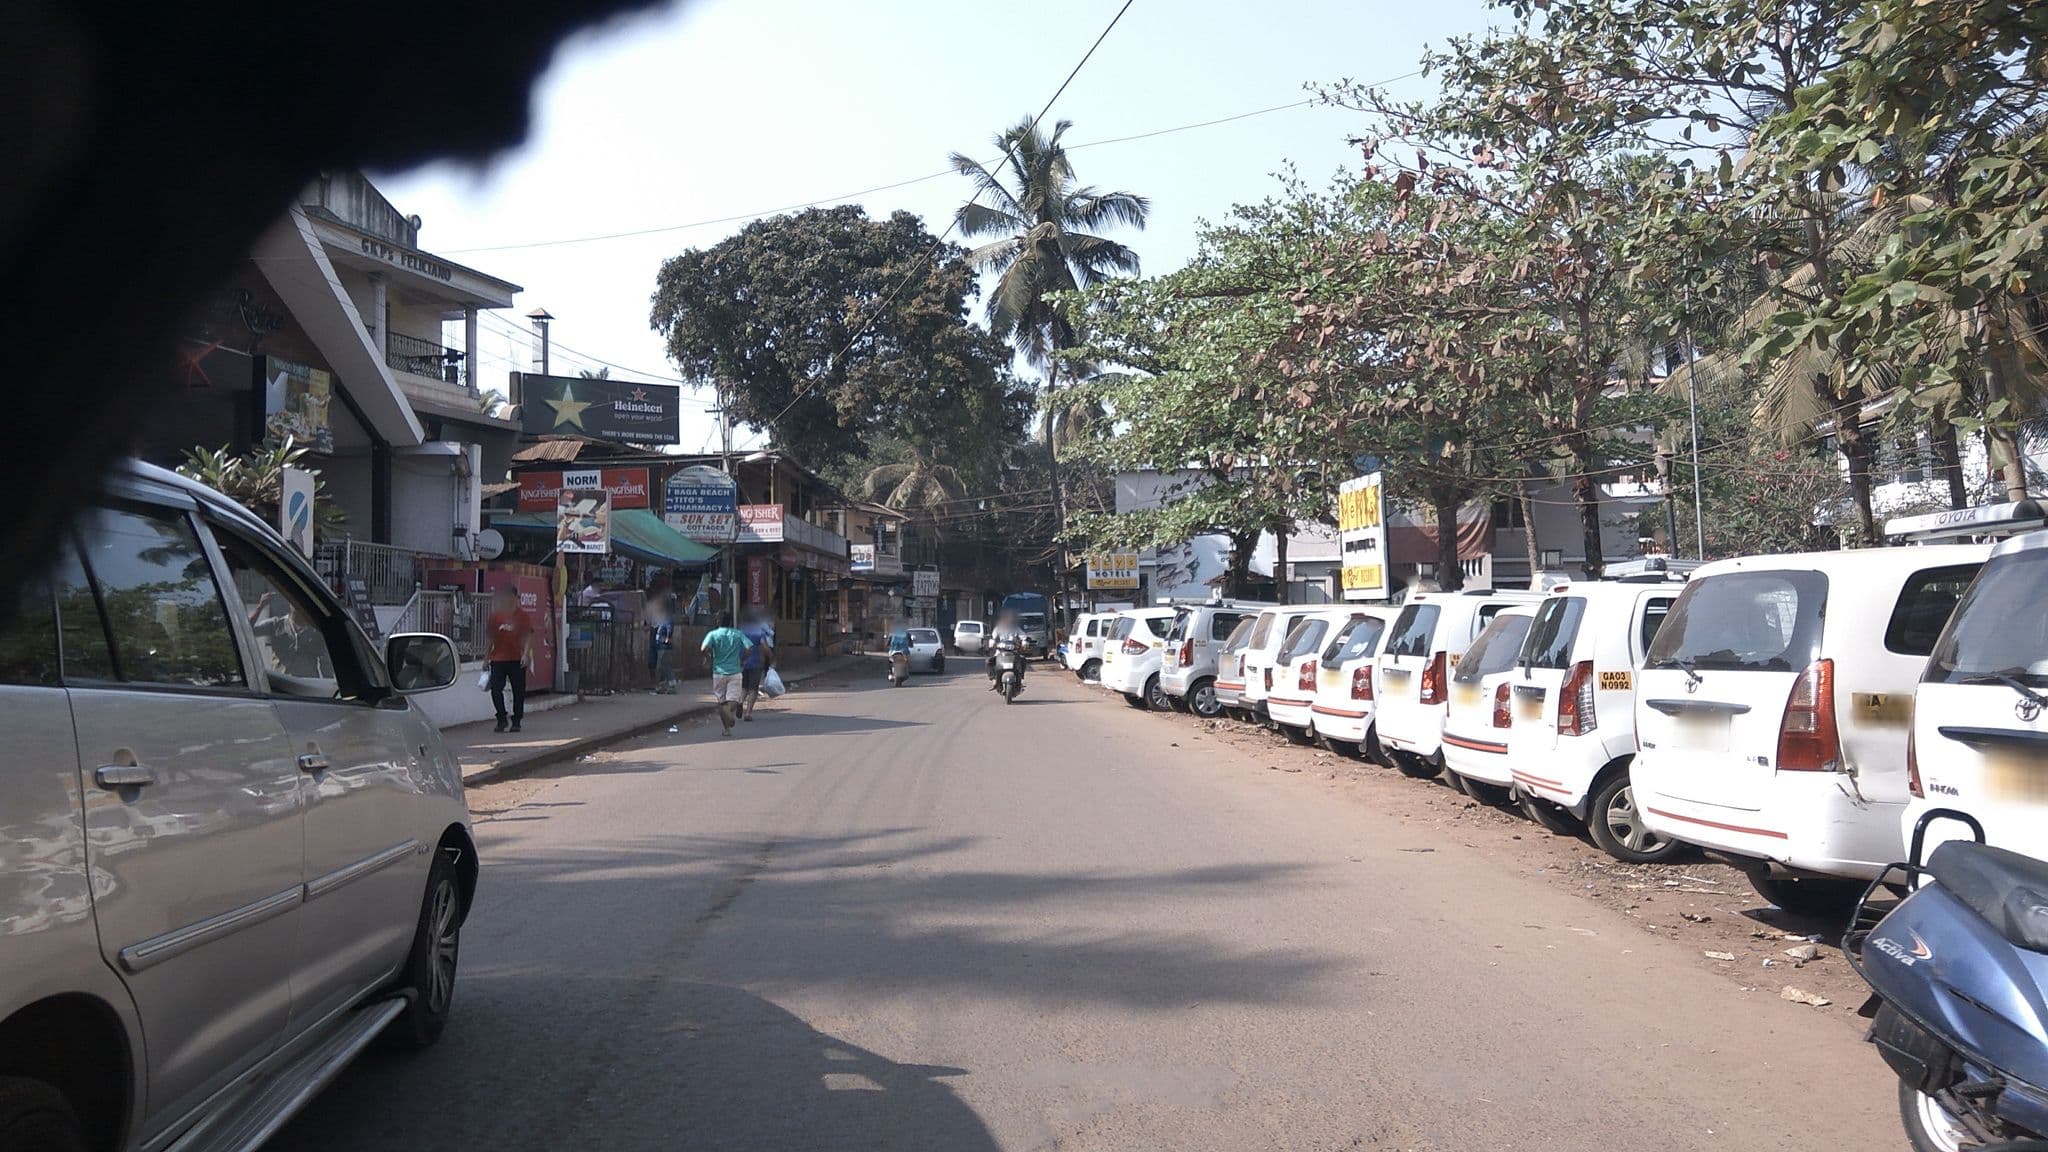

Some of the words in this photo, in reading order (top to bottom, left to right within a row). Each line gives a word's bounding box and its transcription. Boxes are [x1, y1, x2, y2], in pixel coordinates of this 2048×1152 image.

[400, 254, 452, 282] FELICIANO
[614, 400, 663, 413] Heineken
[566, 475, 598, 486] NORM
[674, 488, 698, 496] BAGA
[700, 489, 730, 497] BEACH
[673, 496, 704, 504] TITO'S
[673, 504, 722, 512] PHARMACY
[708, 514, 732, 525] SET
[1934, 509, 1976, 526] TOYOTA
[1095, 570, 1131, 578] HOTELS
[1871, 936, 1918, 967] Activa
